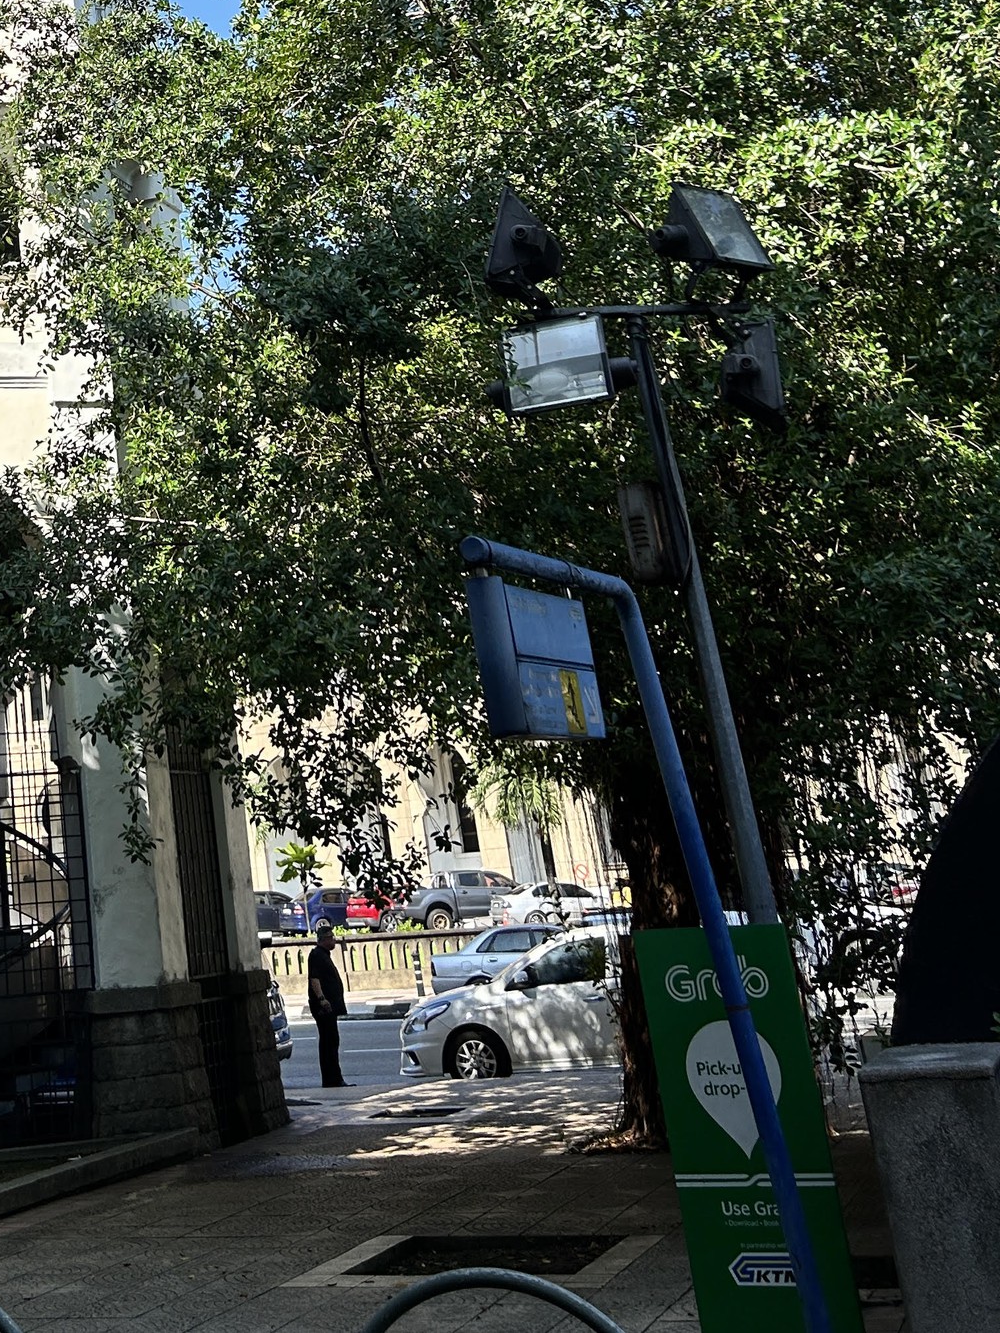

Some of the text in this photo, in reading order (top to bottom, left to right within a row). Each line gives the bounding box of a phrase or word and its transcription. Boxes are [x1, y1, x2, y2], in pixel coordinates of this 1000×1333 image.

[696, 1061, 741, 1076] Pick-u
[704, 1081, 746, 1098] drop-
[721, 1201, 780, 1216] Use Gra
[756, 1270, 796, 1283] KTM
